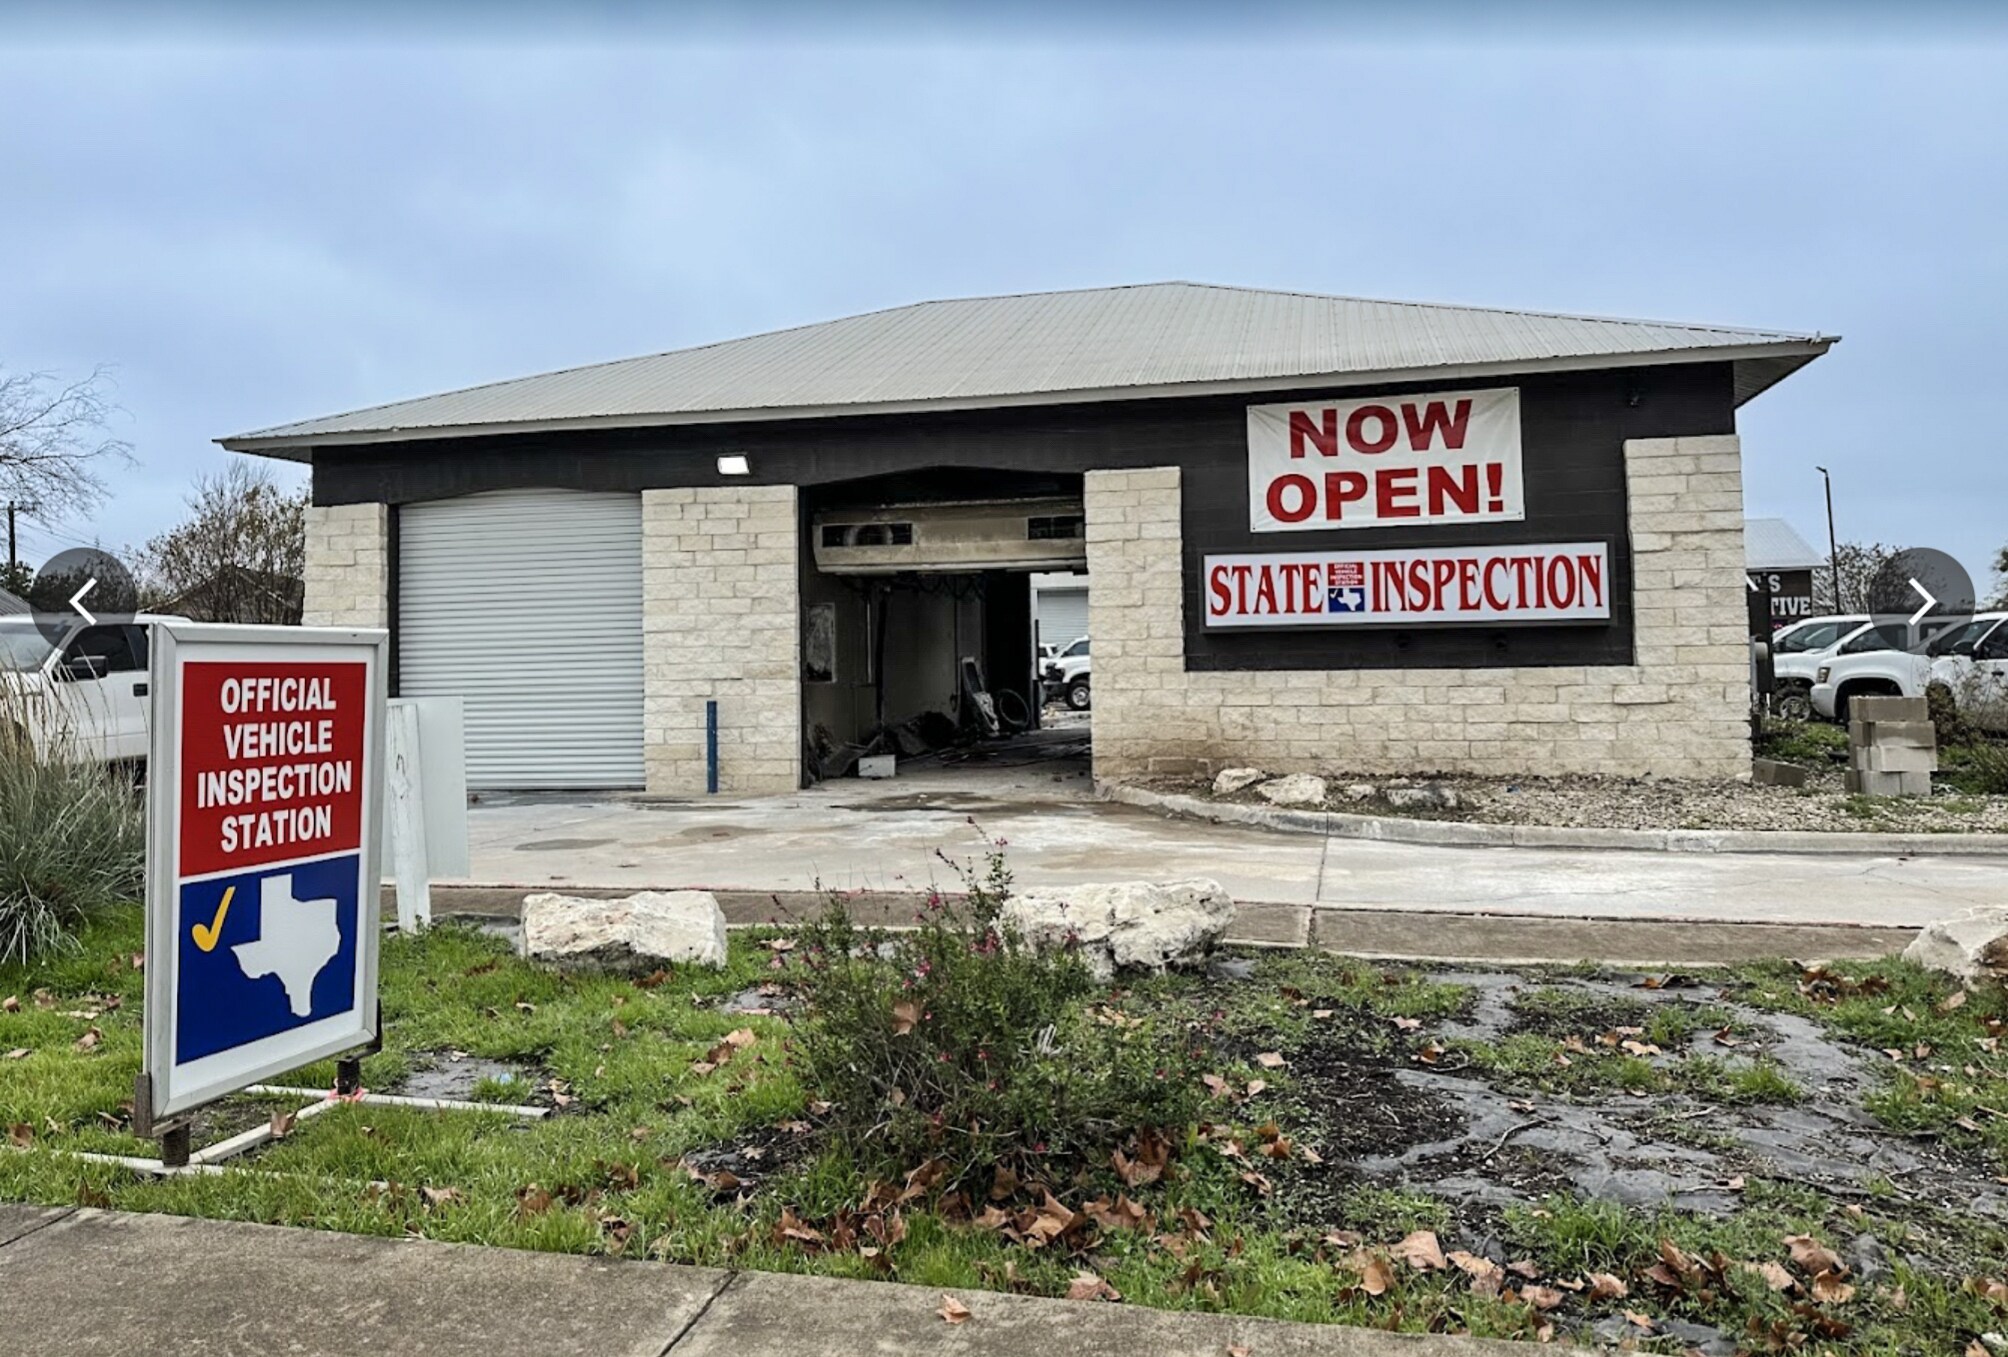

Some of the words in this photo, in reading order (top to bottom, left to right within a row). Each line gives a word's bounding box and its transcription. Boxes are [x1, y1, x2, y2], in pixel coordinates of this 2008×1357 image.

[1289, 399, 1472, 458] NOW
[1266, 462, 1503, 523] OPEN!
[1210, 563, 1323, 616] STATE
[1371, 554, 1602, 612] INSPECTION
[221, 677, 337, 714] OFFICIAL
[223, 720, 333, 760] VEHICLE
[198, 760, 352, 809] INSPECTION
[221, 804, 332, 853] STATION
